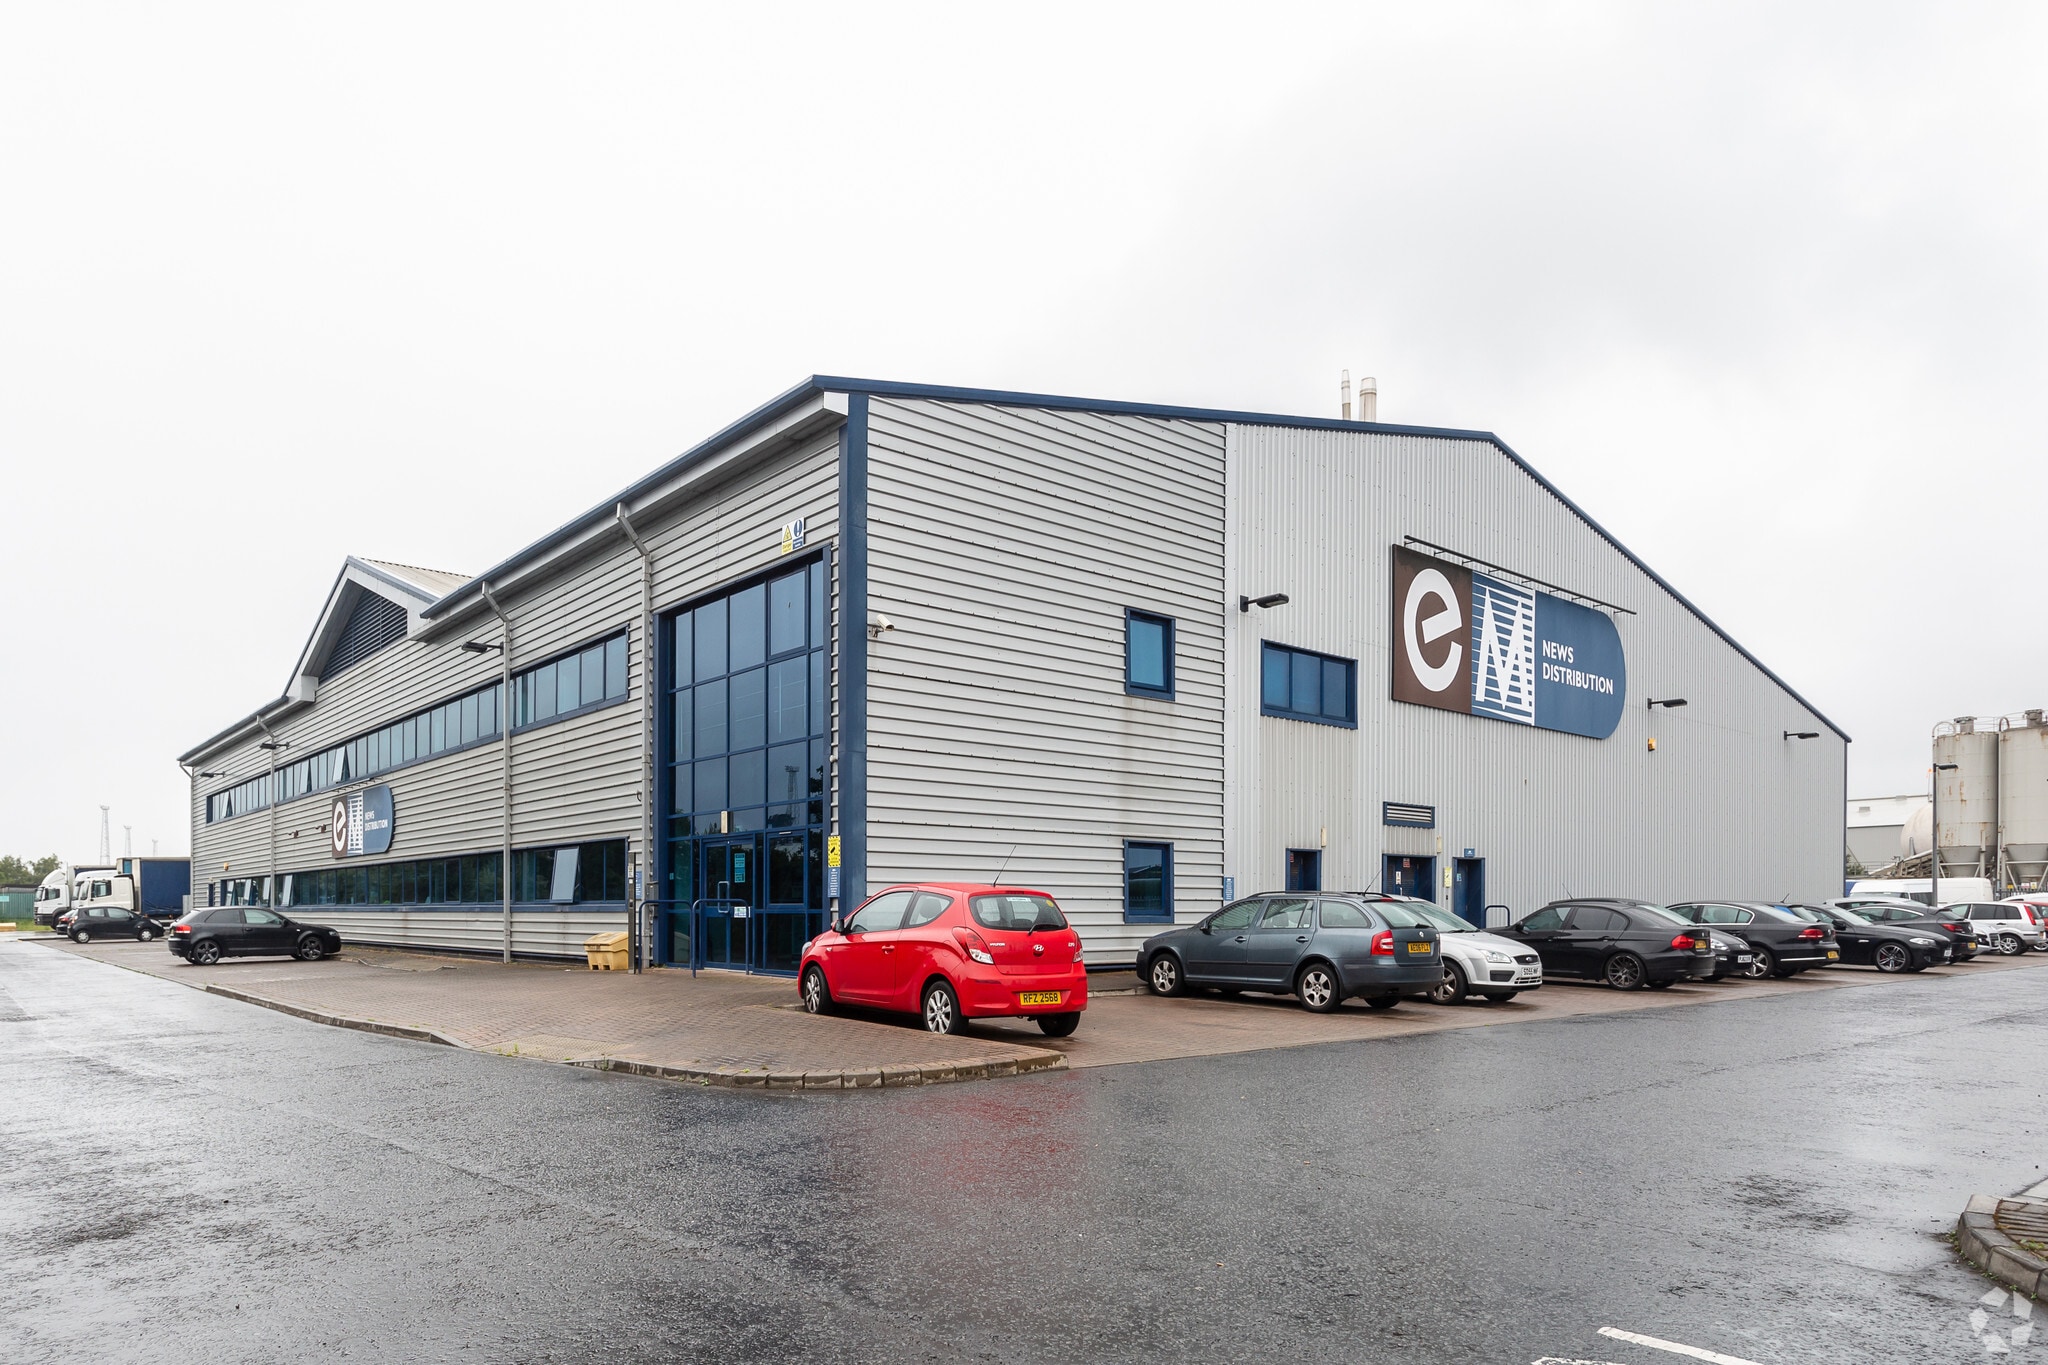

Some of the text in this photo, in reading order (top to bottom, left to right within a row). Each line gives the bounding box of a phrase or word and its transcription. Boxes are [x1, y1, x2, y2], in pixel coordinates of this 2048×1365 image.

[1542, 639, 1574, 664] NEWS
[1542, 662, 1614, 695] DISTRIBUTION
[1023, 992, 1059, 1003] RFZ 2568
